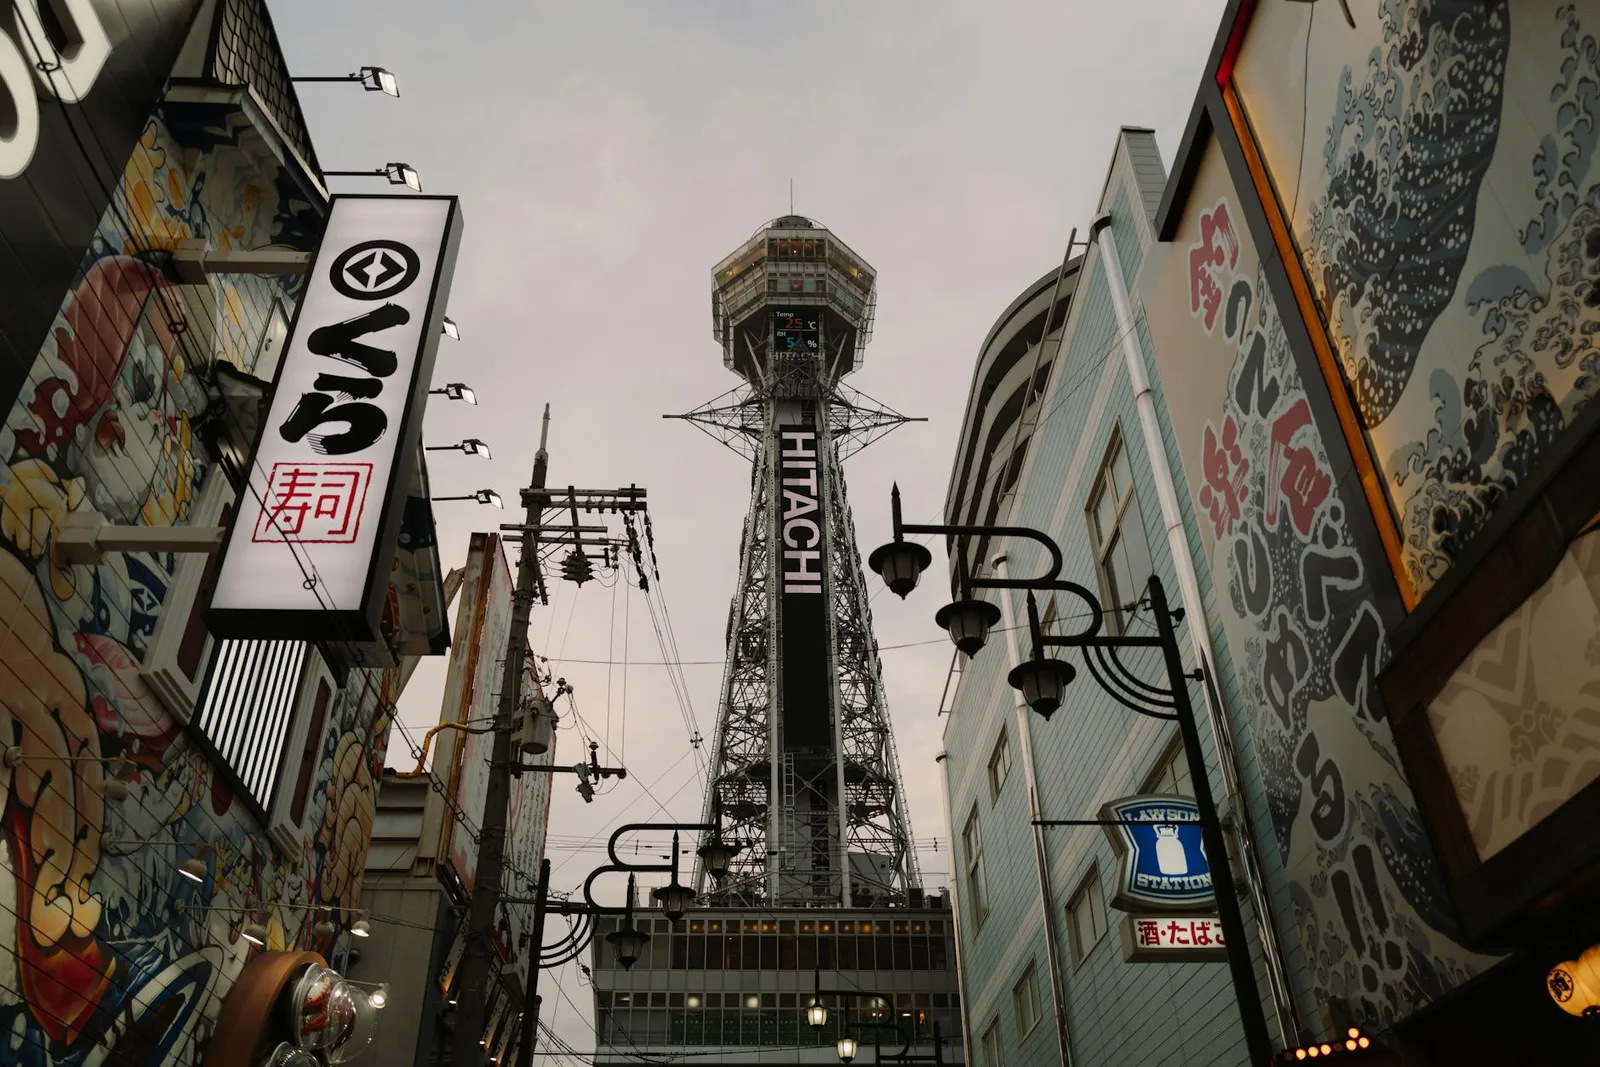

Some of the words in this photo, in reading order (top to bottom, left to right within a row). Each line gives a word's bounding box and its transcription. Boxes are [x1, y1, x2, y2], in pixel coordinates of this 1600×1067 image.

[279, 301, 411, 456] くら
[264, 468, 361, 536] 寿司
[781, 431, 823, 594] HITACHI
[1136, 872, 1213, 891] STATION
